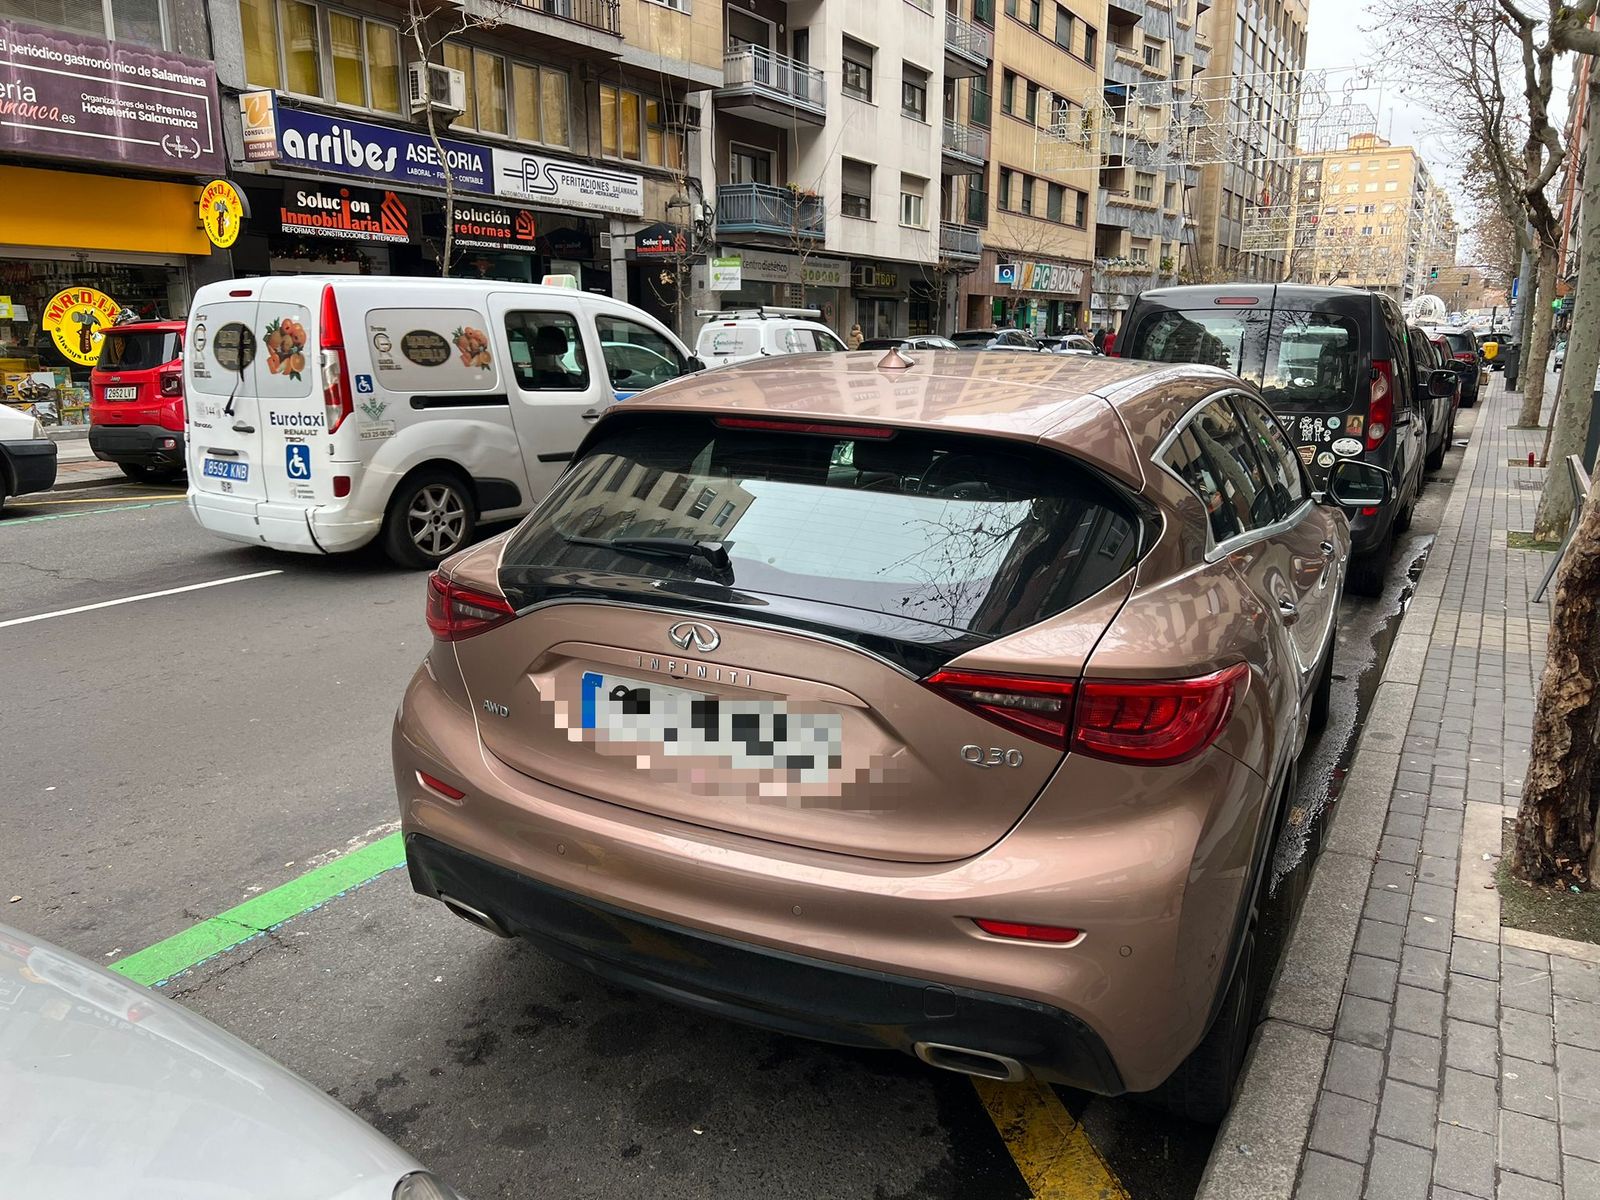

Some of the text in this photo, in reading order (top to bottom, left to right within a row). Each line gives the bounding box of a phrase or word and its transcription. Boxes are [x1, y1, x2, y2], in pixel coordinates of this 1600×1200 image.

[9, 43, 62, 61] periódico
[64, 53, 137, 75] gastronómico
[138, 65, 151, 77] de
[152, 68, 207, 88] Salamanca
[80, 93, 197, 119] Organizadores de los Premios
[82, 102, 198, 129] Hostelería Salamanca
[282, 125, 398, 173] arribes
[406, 143, 484, 173] ASESORIA
[407, 167, 432, 177] LABORAL
[459, 176, 485, 185] CONTABLE
[521, 157, 559, 195] PS
[561, 175, 639, 196] PERITACIONES SALAMANCA
[280, 206, 382, 233] Inmobiliaria
[454, 208, 511, 225] solución
[282, 225, 316, 235] REFORMAS
[318, 228, 371, 240] CONSTRUCCIONES
[454, 223, 512, 238] reformas
[455, 239, 536, 252] CONSTRUCCIONES INTERIORISMO
[56, 334, 82, 360] Always
[269, 411, 325, 426] Eurotaxi
[284, 428, 318, 436] RENAULT
[208, 461, 247, 479] 8592 KNB
[637, 655, 752, 687] INFINITI
[483, 699, 509, 718] AWD
[960, 744, 1023, 769] Q30
